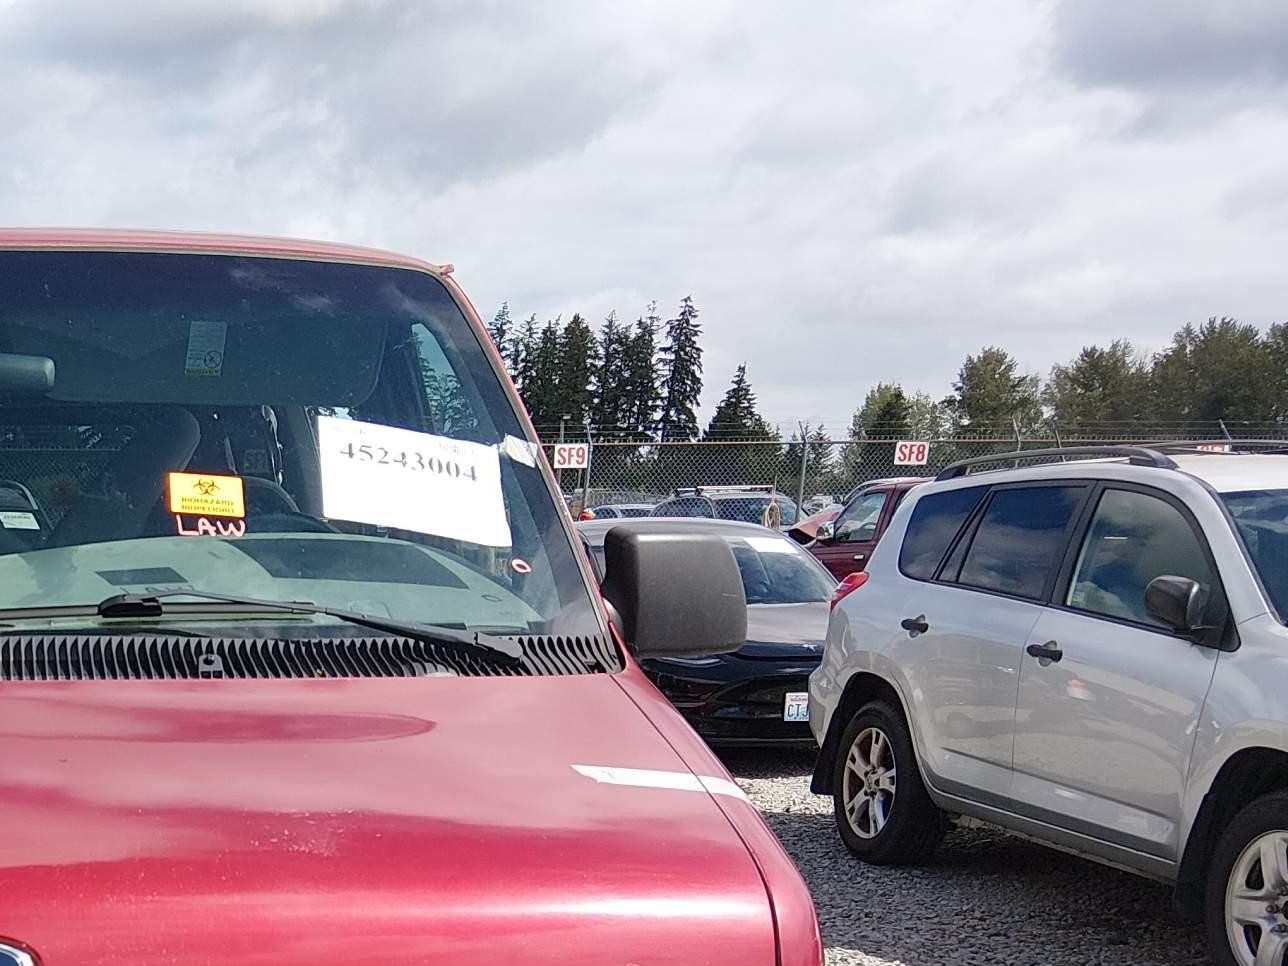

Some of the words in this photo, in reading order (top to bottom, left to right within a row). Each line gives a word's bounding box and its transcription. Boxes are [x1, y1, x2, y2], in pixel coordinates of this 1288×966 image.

[339, 442, 479, 482] 45243004
[557, 446, 586, 466] SF9
[897, 443, 927, 462] SF8
[175, 514, 246, 537] LAW
